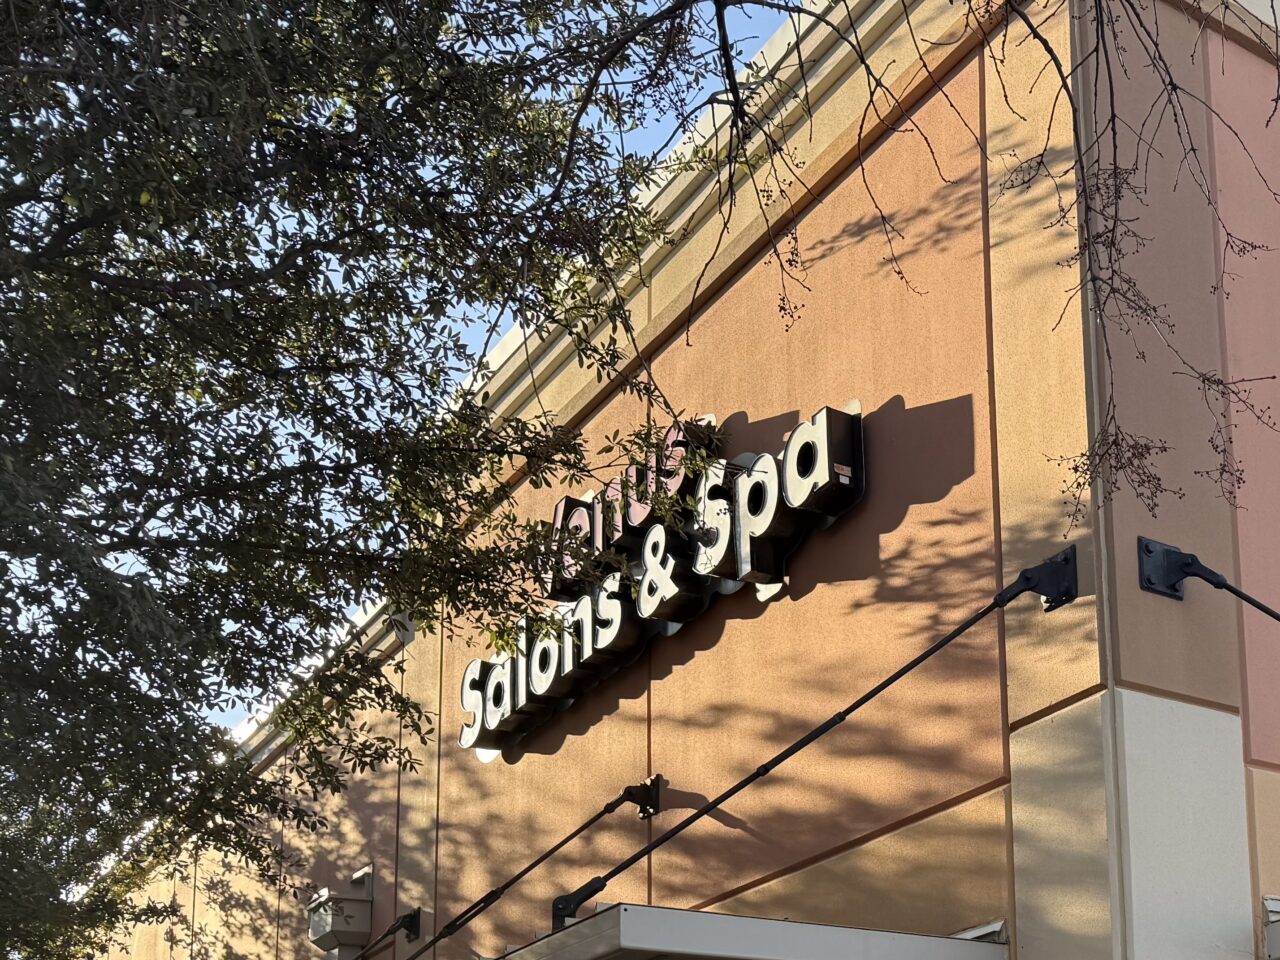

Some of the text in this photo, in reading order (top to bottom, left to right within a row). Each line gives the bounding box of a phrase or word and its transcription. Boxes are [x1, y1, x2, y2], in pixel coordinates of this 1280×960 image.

[458, 406, 832, 748] Salons & Spa
[538, 424, 686, 598] enus
